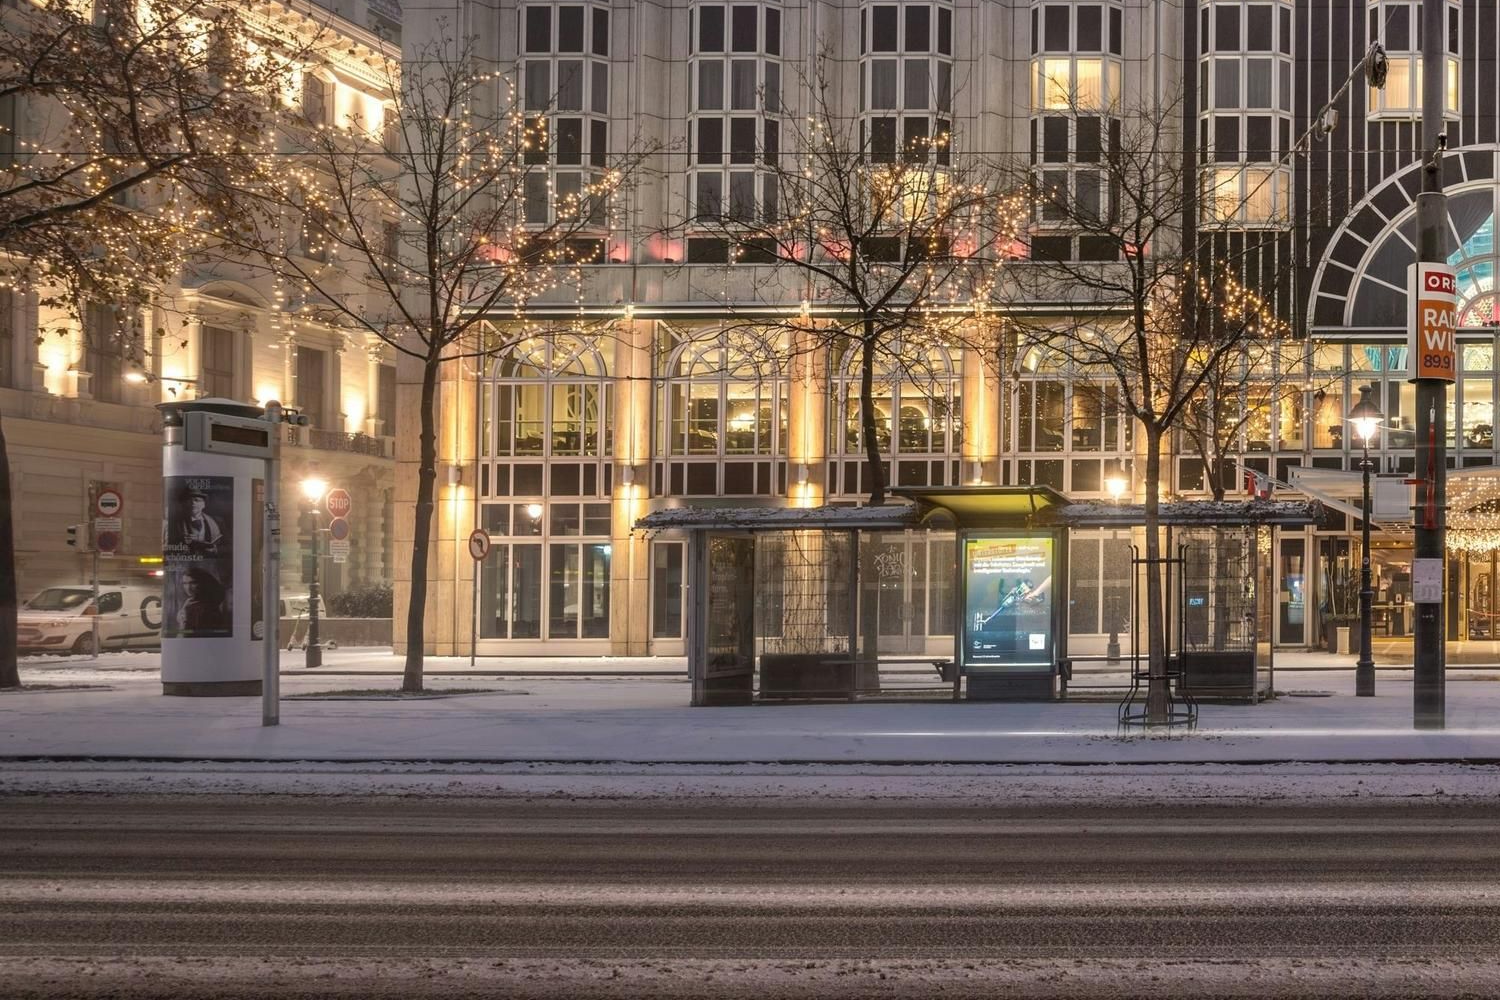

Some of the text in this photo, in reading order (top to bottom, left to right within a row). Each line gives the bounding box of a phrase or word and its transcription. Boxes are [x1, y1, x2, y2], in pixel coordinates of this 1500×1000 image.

[1428, 276, 1456, 291] ORF
[1424, 354, 1450, 369] 89.9
[329, 498, 348, 509] STOP
